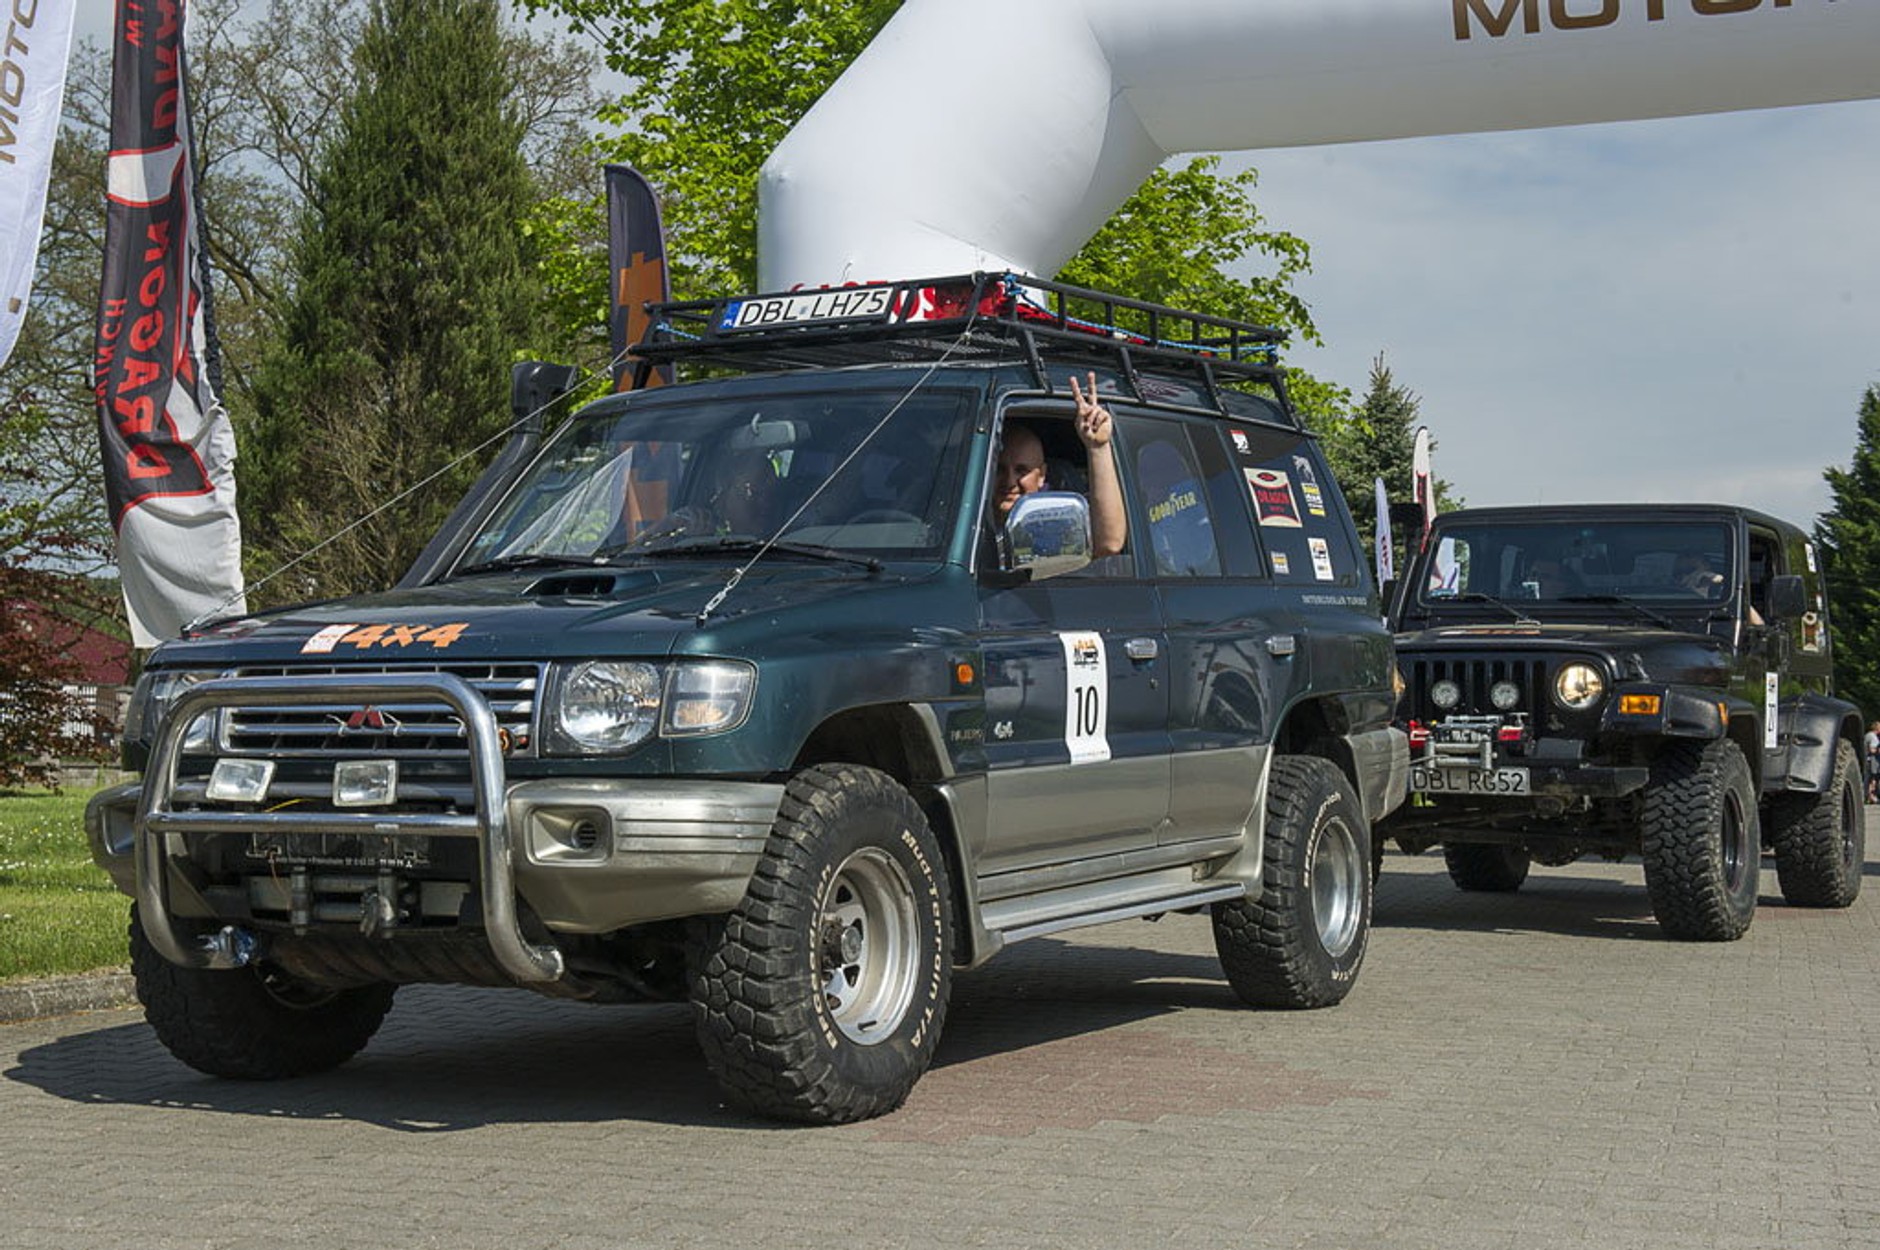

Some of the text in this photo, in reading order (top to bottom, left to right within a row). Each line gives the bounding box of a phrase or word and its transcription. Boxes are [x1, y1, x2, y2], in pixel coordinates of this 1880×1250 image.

[739, 299, 798, 326] DBL
[810, 291, 888, 318] LH75
[1074, 685, 1099, 737] 10
[1412, 768, 1524, 793] DBL RG52
[901, 829, 941, 1000] Mud-Terrain
